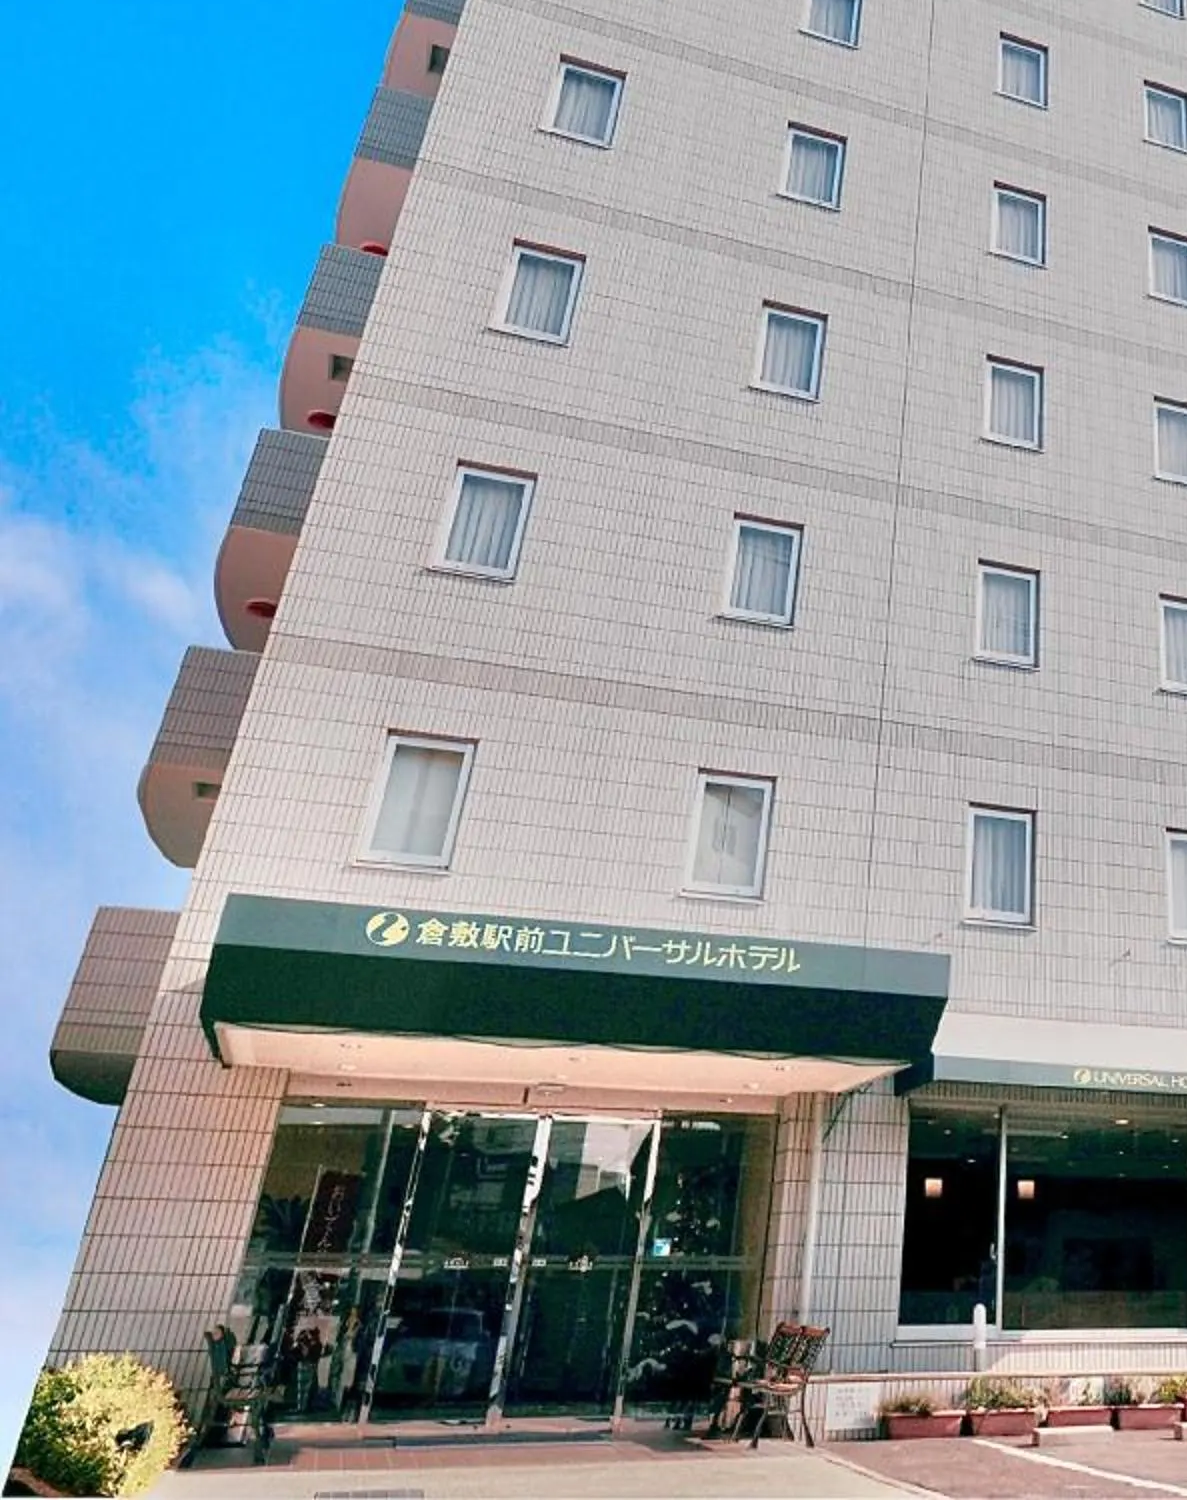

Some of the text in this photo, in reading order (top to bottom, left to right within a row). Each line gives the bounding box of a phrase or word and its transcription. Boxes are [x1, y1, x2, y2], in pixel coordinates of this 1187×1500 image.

[415, 918, 801, 973] 倉敷駅前ユニバーサルホテル
[1094, 1070, 1169, 1088] UNIVERSAL
